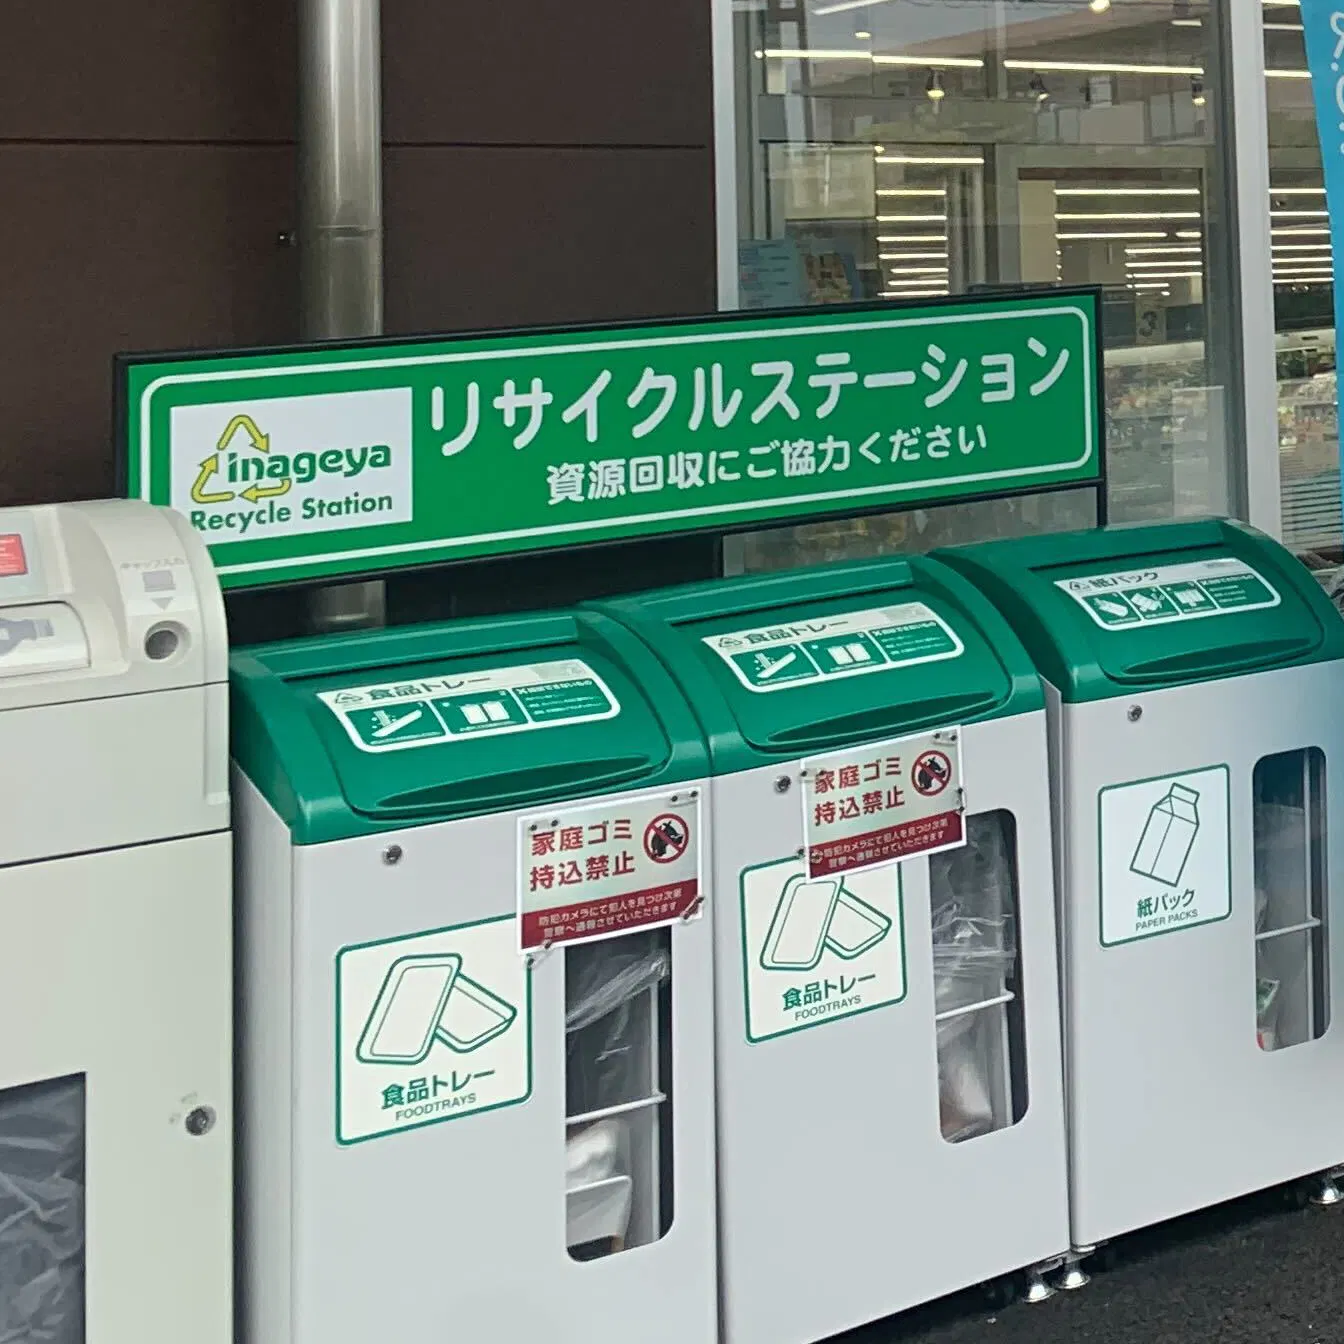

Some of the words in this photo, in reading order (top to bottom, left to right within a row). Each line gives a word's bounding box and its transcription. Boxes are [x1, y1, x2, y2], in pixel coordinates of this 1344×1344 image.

[430, 336, 1070, 457] リサイクルステーション
[227, 444, 392, 484] inageya
[545, 424, 987, 506] 資源回収にご協力ください
[190, 500, 292, 534] Recycle
[301, 491, 393, 520] Station
[744, 620, 849, 645] 食品トレー
[366, 676, 492, 702] 食品トレー
[814, 757, 902, 795] 家庭ゴミ
[814, 786, 905, 827] 持込禁止
[531, 819, 633, 857] 家庭ゴミ
[529, 850, 635, 892] 持込禁止
[1135, 917, 1166, 932] PAPER
[1167, 908, 1199, 924] PACKS
[782, 973, 876, 1012] 食品トレー
[794, 994, 862, 1022] FOODTRAYS
[381, 1068, 496, 1110] 食品トレー
[395, 1092, 477, 1121] FOODTRAYS
